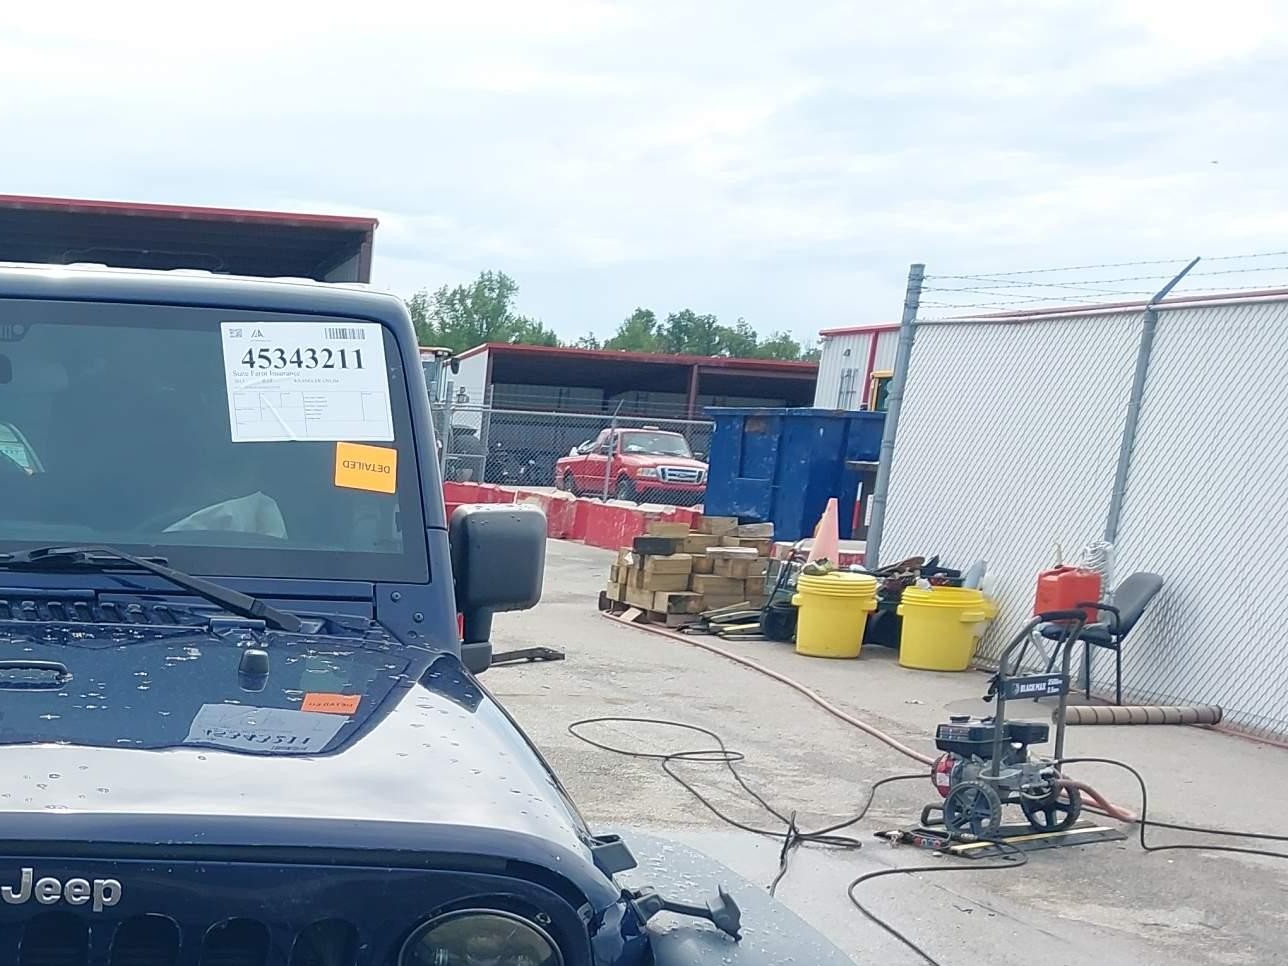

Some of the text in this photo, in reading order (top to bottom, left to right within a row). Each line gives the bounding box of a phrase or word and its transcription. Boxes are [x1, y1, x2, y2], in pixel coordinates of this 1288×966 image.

[241, 347, 366, 369] 45343211
[342, 460, 391, 474] DETAILED
[0, 867, 122, 912] Jeep
